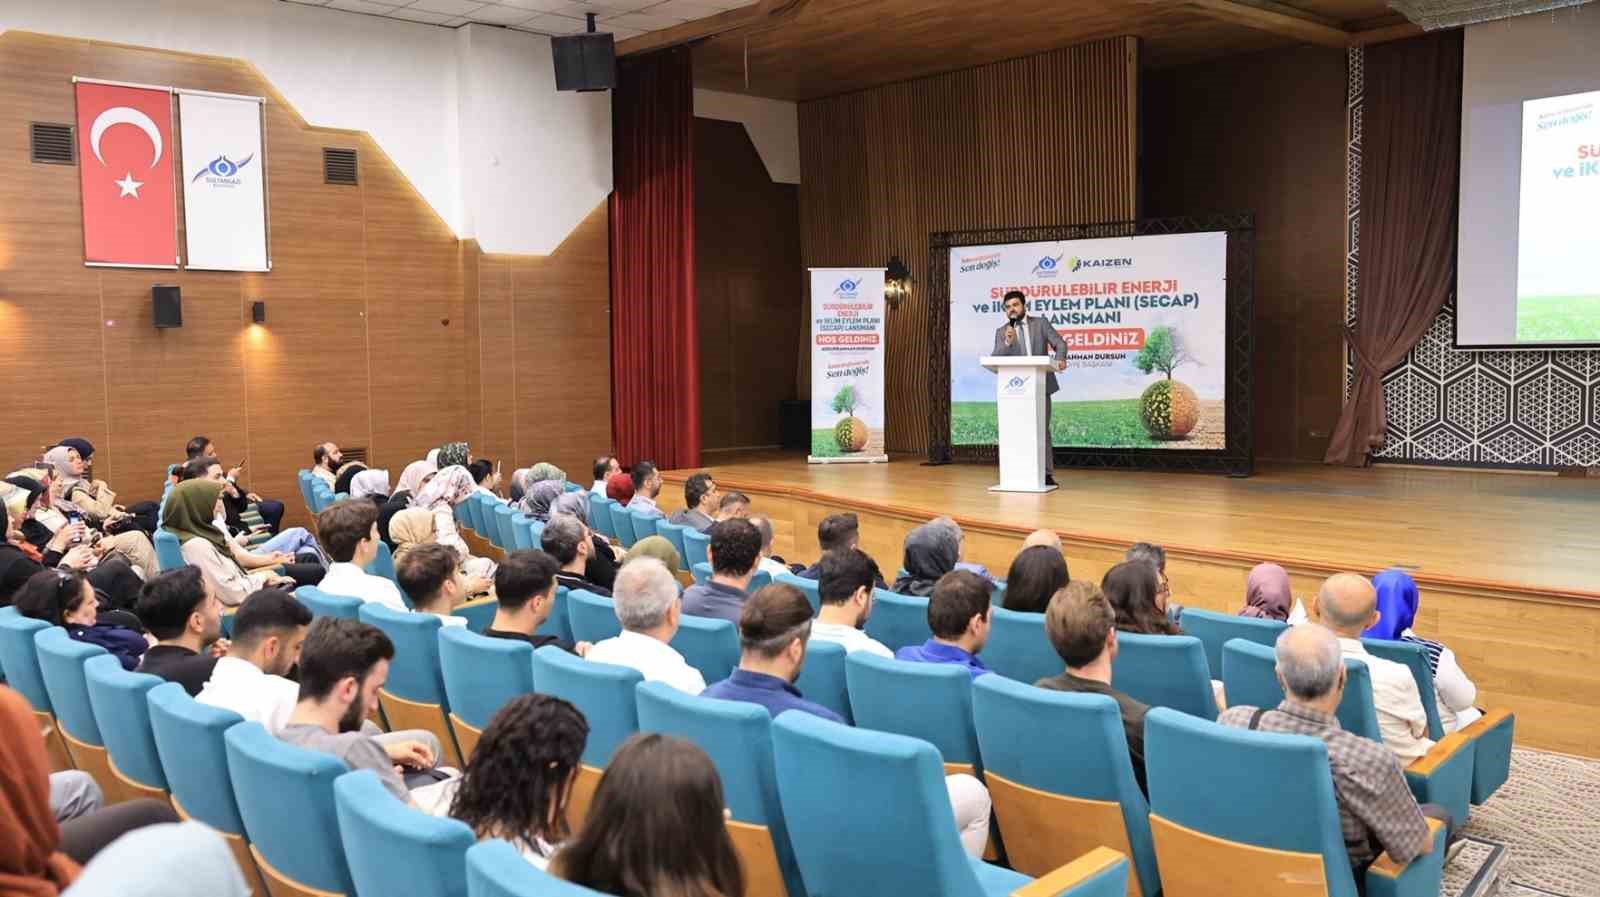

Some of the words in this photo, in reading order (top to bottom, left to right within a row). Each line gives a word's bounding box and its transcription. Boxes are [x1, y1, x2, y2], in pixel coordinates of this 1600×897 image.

[1552, 166, 1575, 179] ve
[1083, 258, 1132, 268] KAIZEN
[973, 304, 989, 313] ve
[1035, 298, 1080, 312] EYLEM
[1085, 296, 1130, 310] PLANI
[1135, 292, 1199, 311] (SECAP)
